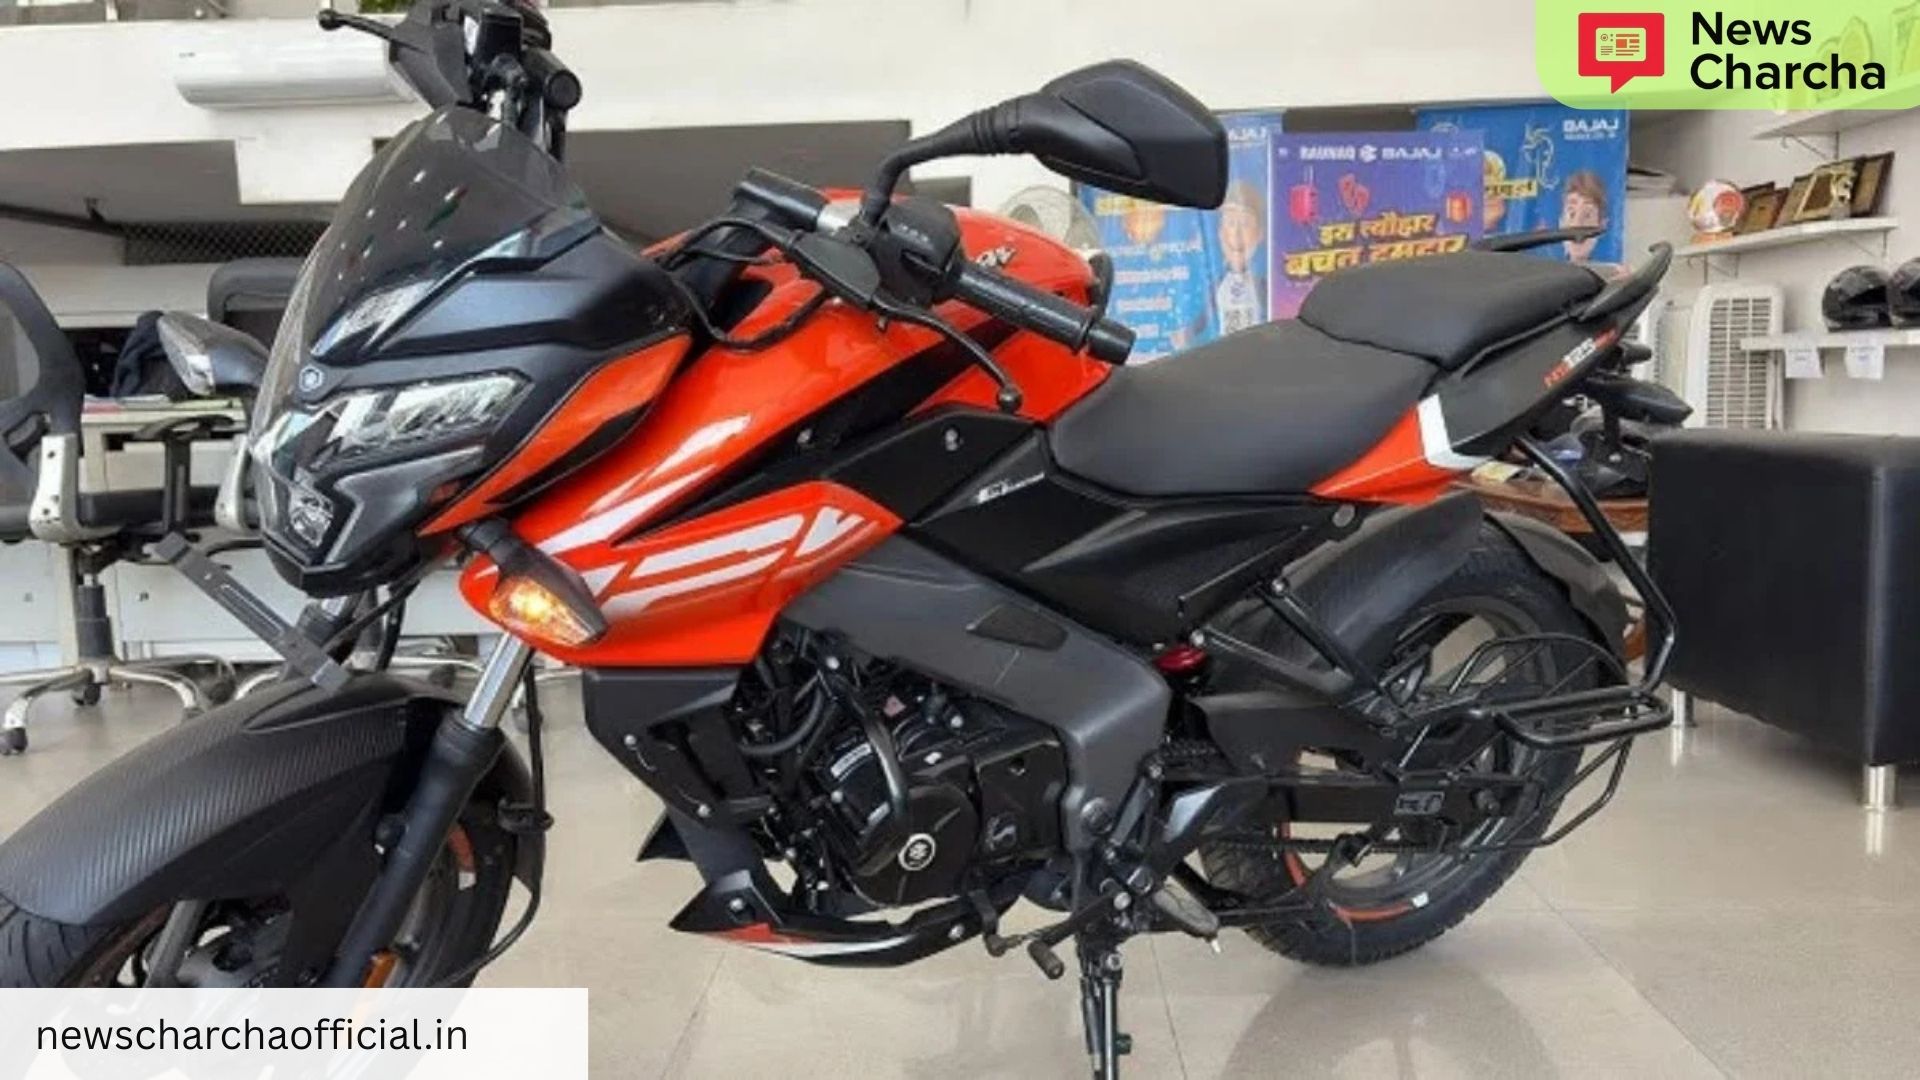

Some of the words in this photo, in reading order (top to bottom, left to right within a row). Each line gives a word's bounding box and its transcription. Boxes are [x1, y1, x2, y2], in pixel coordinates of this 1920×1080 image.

[1563, 118, 1619, 133] BAJAJ
[1382, 147, 1442, 160] BAJAJ
[1319, 222, 1355, 247] इस
[1285, 248, 1362, 277] बचत
